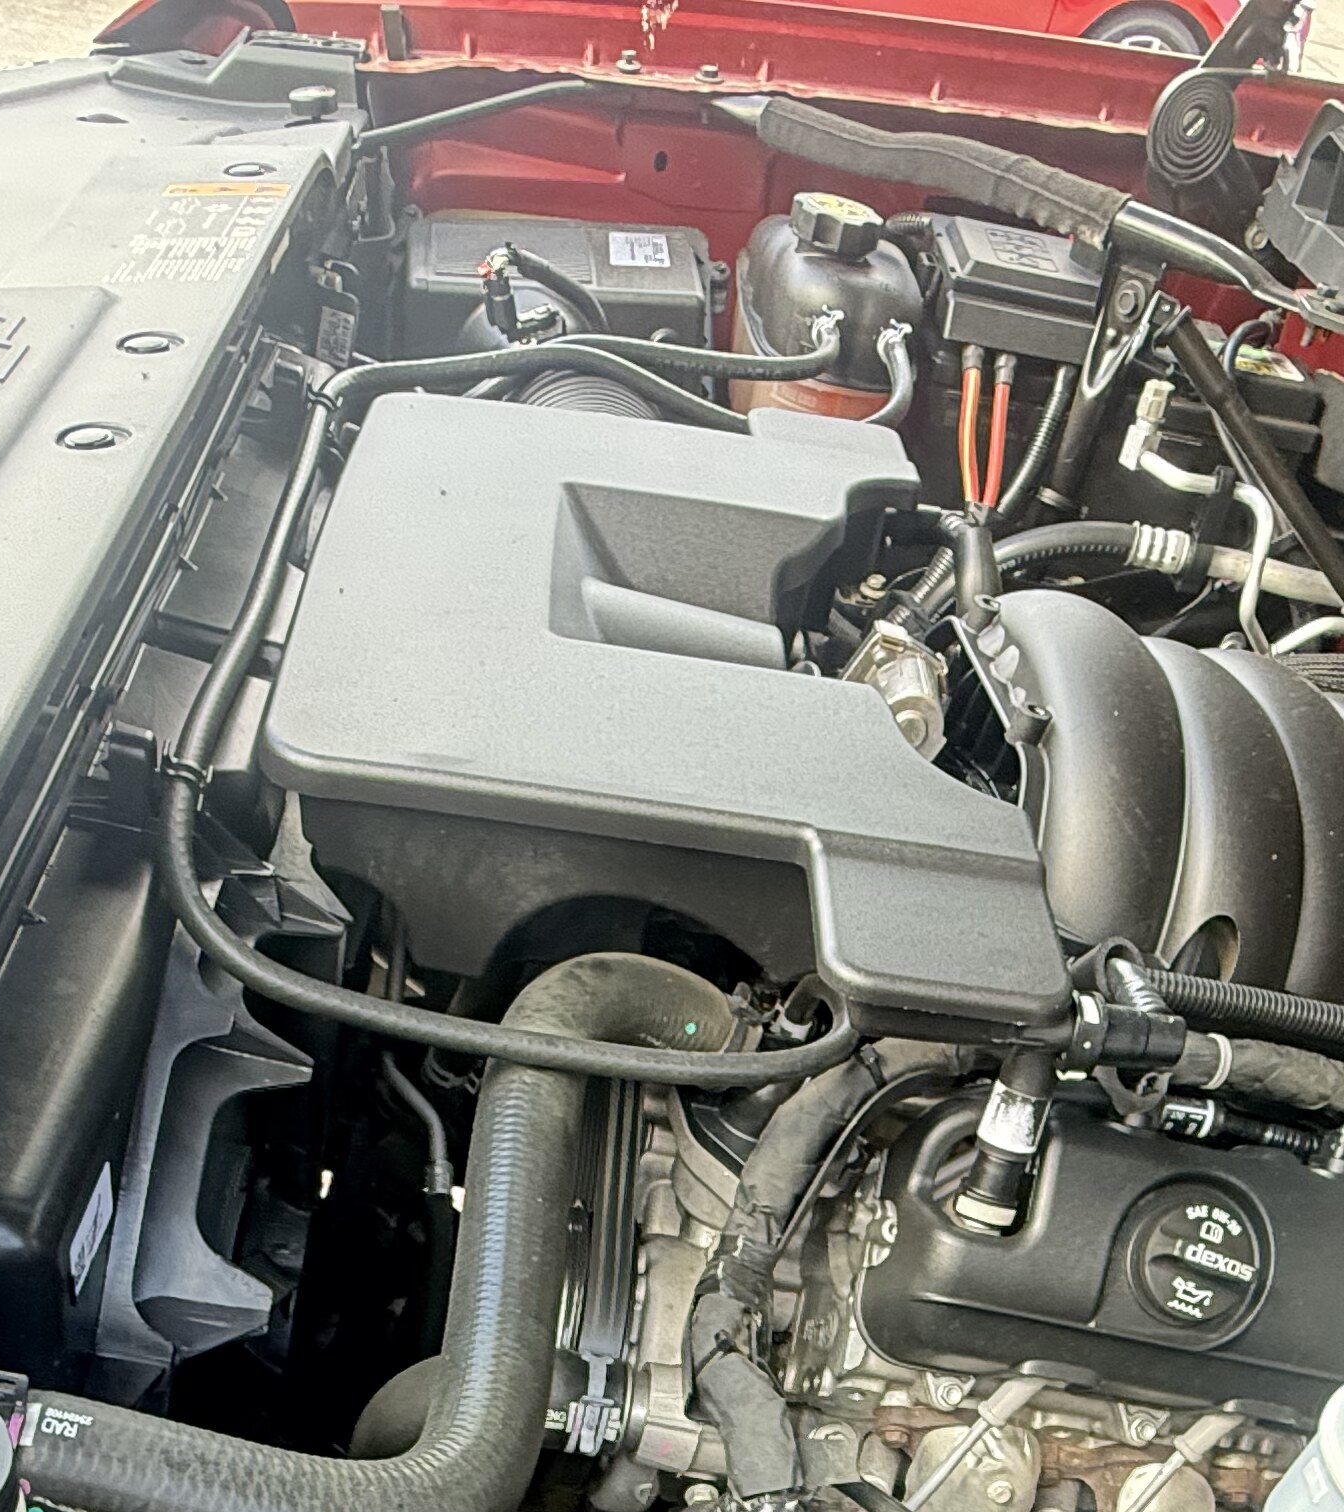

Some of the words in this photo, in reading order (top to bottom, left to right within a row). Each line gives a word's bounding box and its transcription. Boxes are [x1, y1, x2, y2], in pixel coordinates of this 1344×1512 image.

[1185, 1204, 1209, 1220] SAE
[1184, 1243, 1256, 1281] dexos
[41, 1417, 78, 1438] RAD
